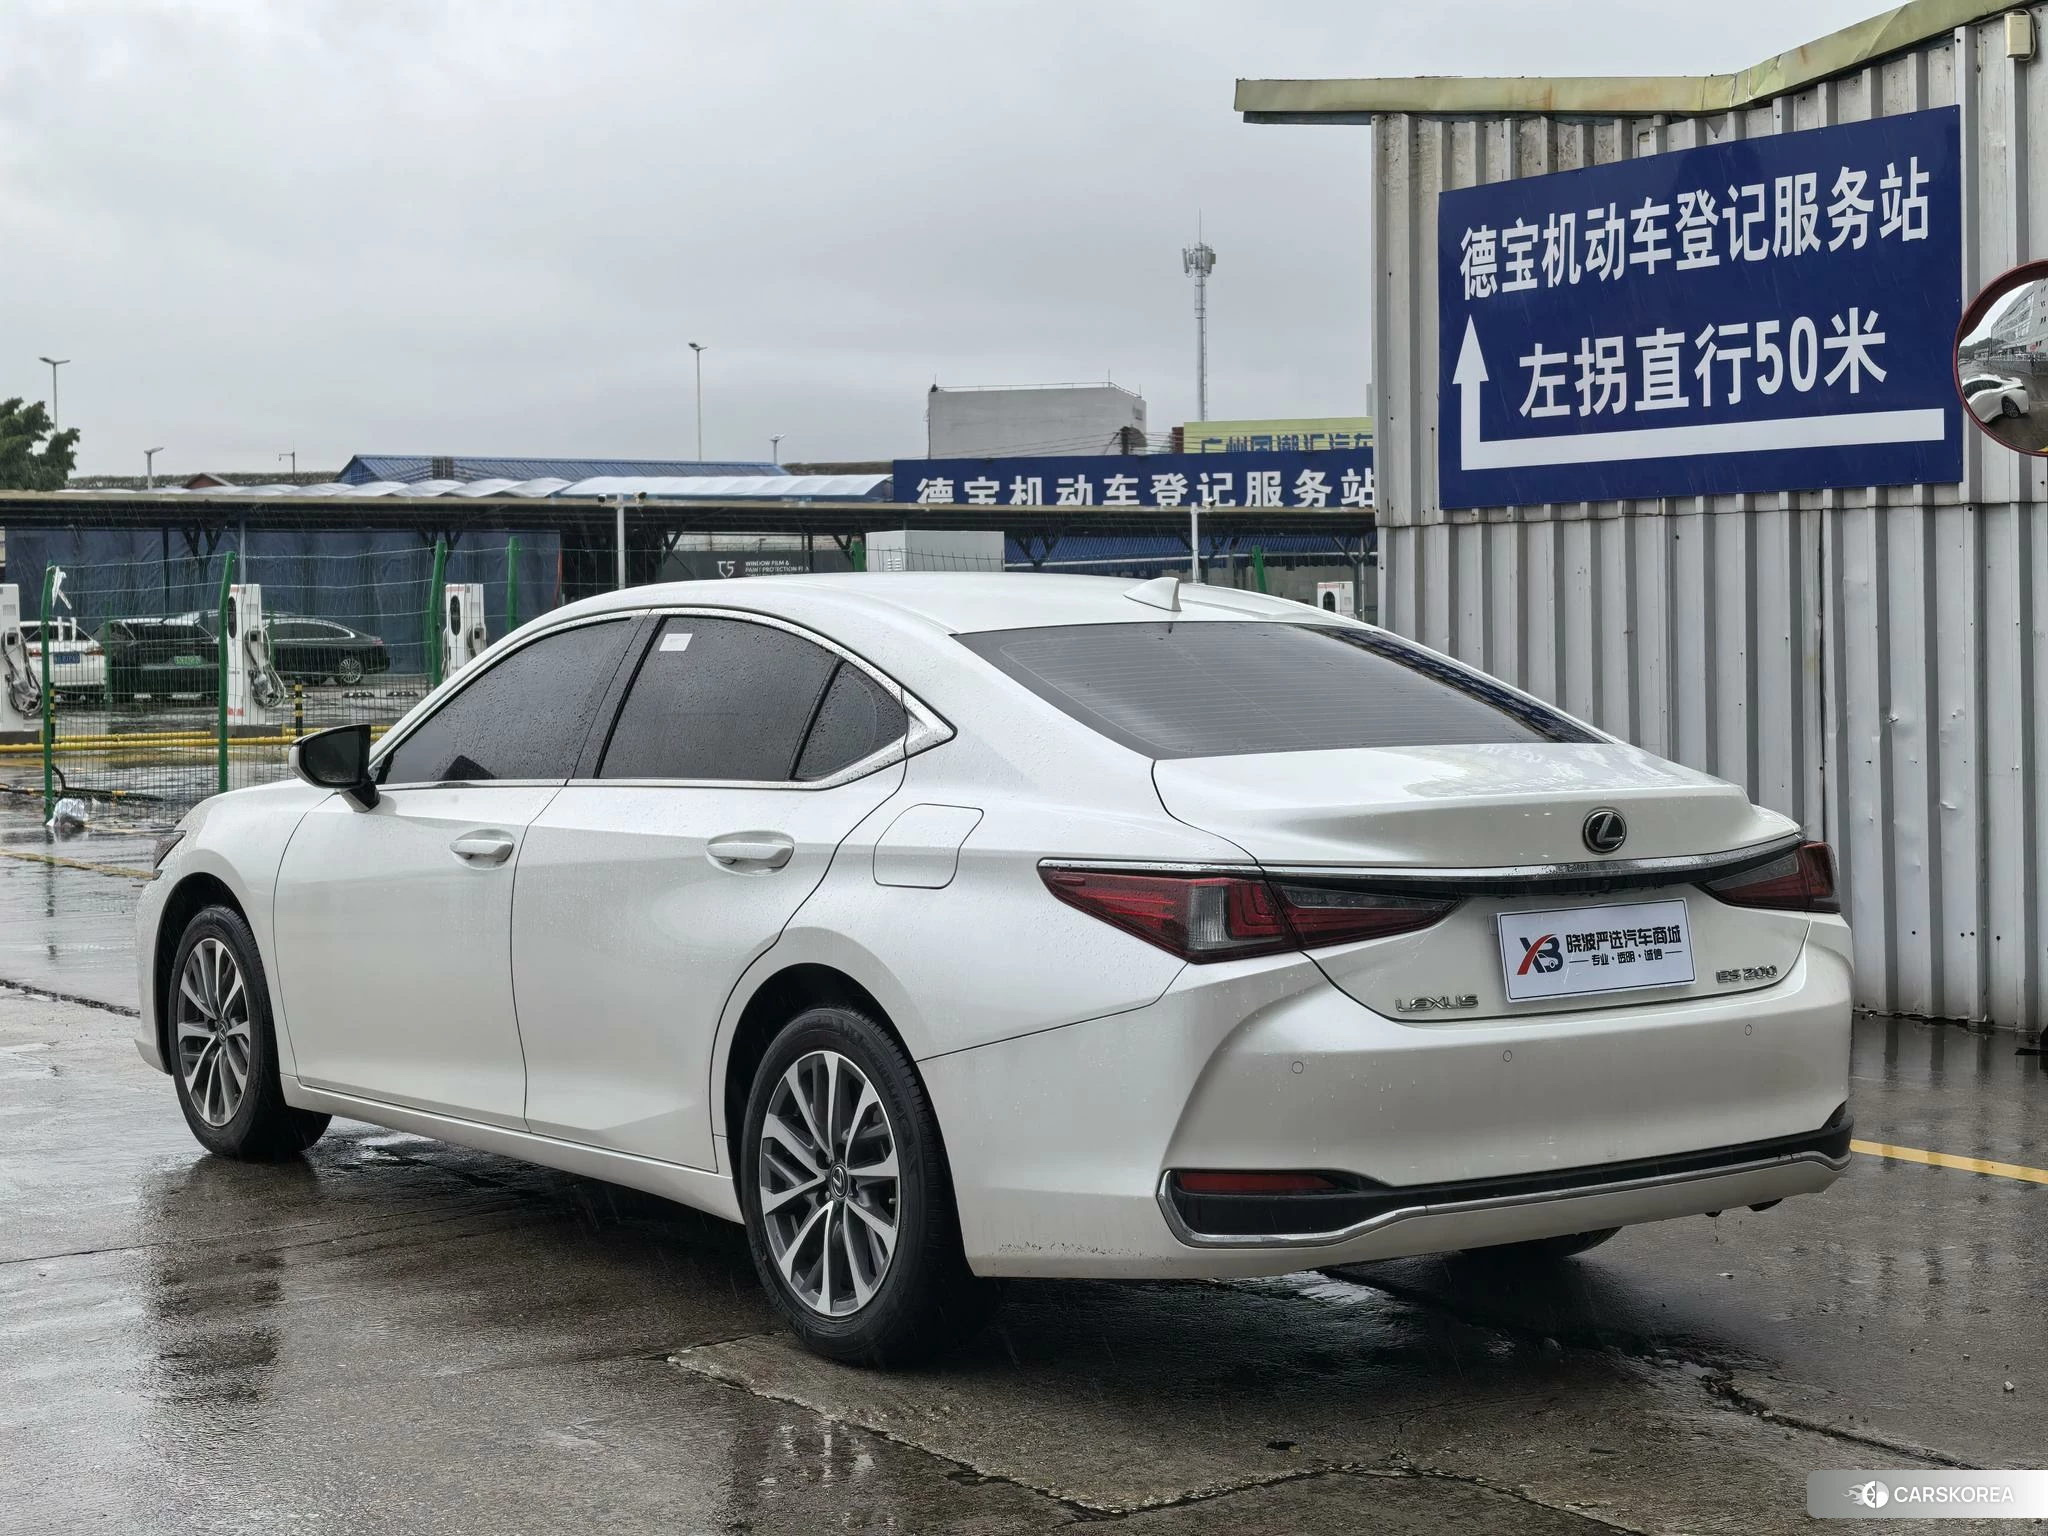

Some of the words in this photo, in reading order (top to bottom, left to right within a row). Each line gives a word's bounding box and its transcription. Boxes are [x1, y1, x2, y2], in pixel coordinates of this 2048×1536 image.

[1460, 157, 1930, 300] 德宝机动车登记服务站
[1519, 307, 1887, 419] 左拐直行50米
[916, 467, 1376, 509] 德宝机动车登记服务站
[1565, 924, 1682, 954] 晓波严选汽车商城
[1715, 968, 1742, 984] ES
[1395, 993, 1479, 1013] LEXUS
